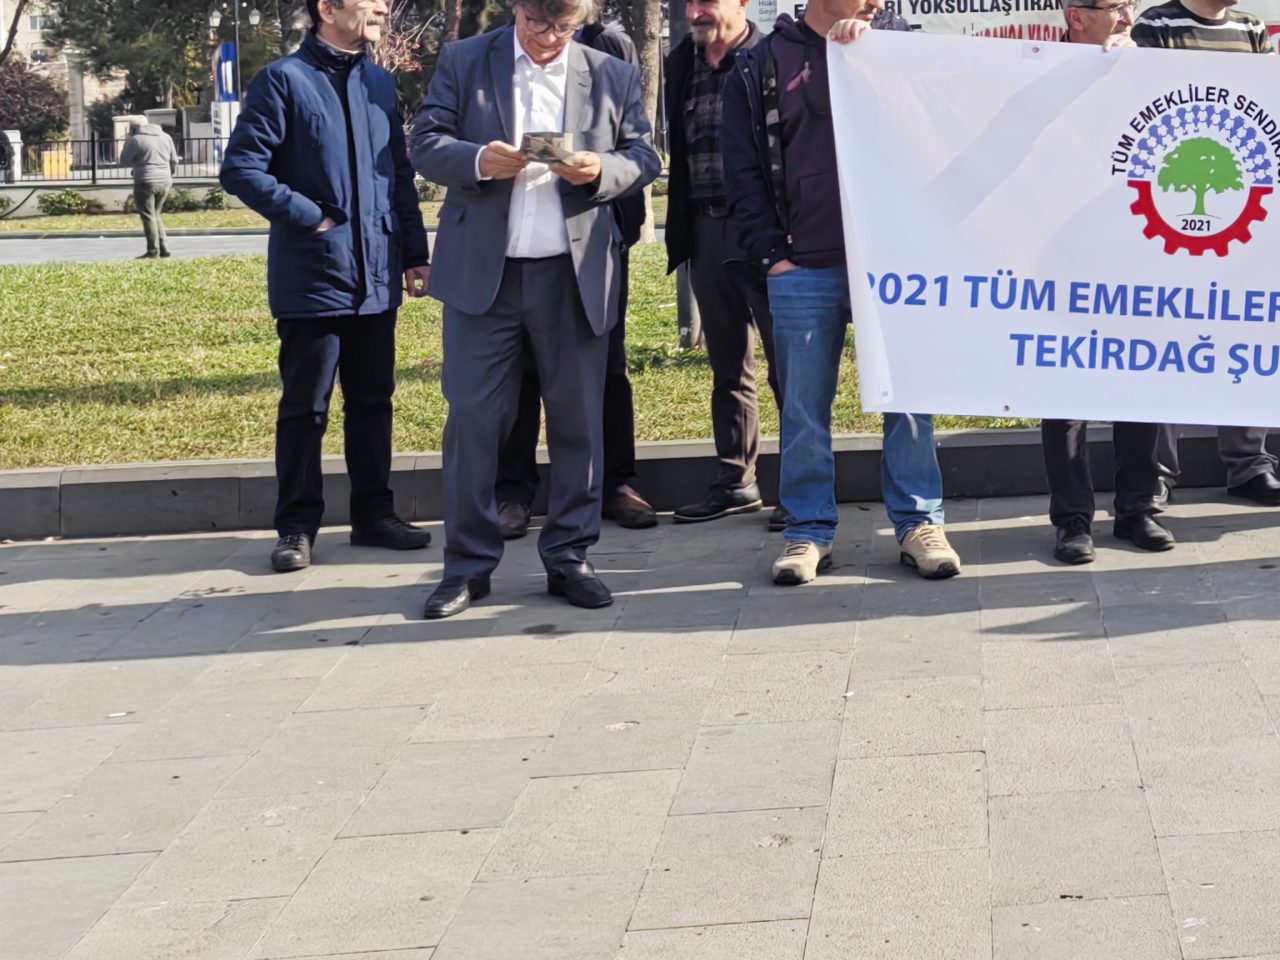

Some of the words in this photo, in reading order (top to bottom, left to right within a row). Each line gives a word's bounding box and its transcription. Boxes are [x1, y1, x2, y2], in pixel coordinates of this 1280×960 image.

[1111, 134, 1135, 175] TÜM
[1130, 83, 1230, 133] EMEKLİLER
[1181, 218, 1211, 231] 2021
[963, 268, 1056, 311] TÜM
[1010, 329, 1215, 375] TEKİRDAĞ
